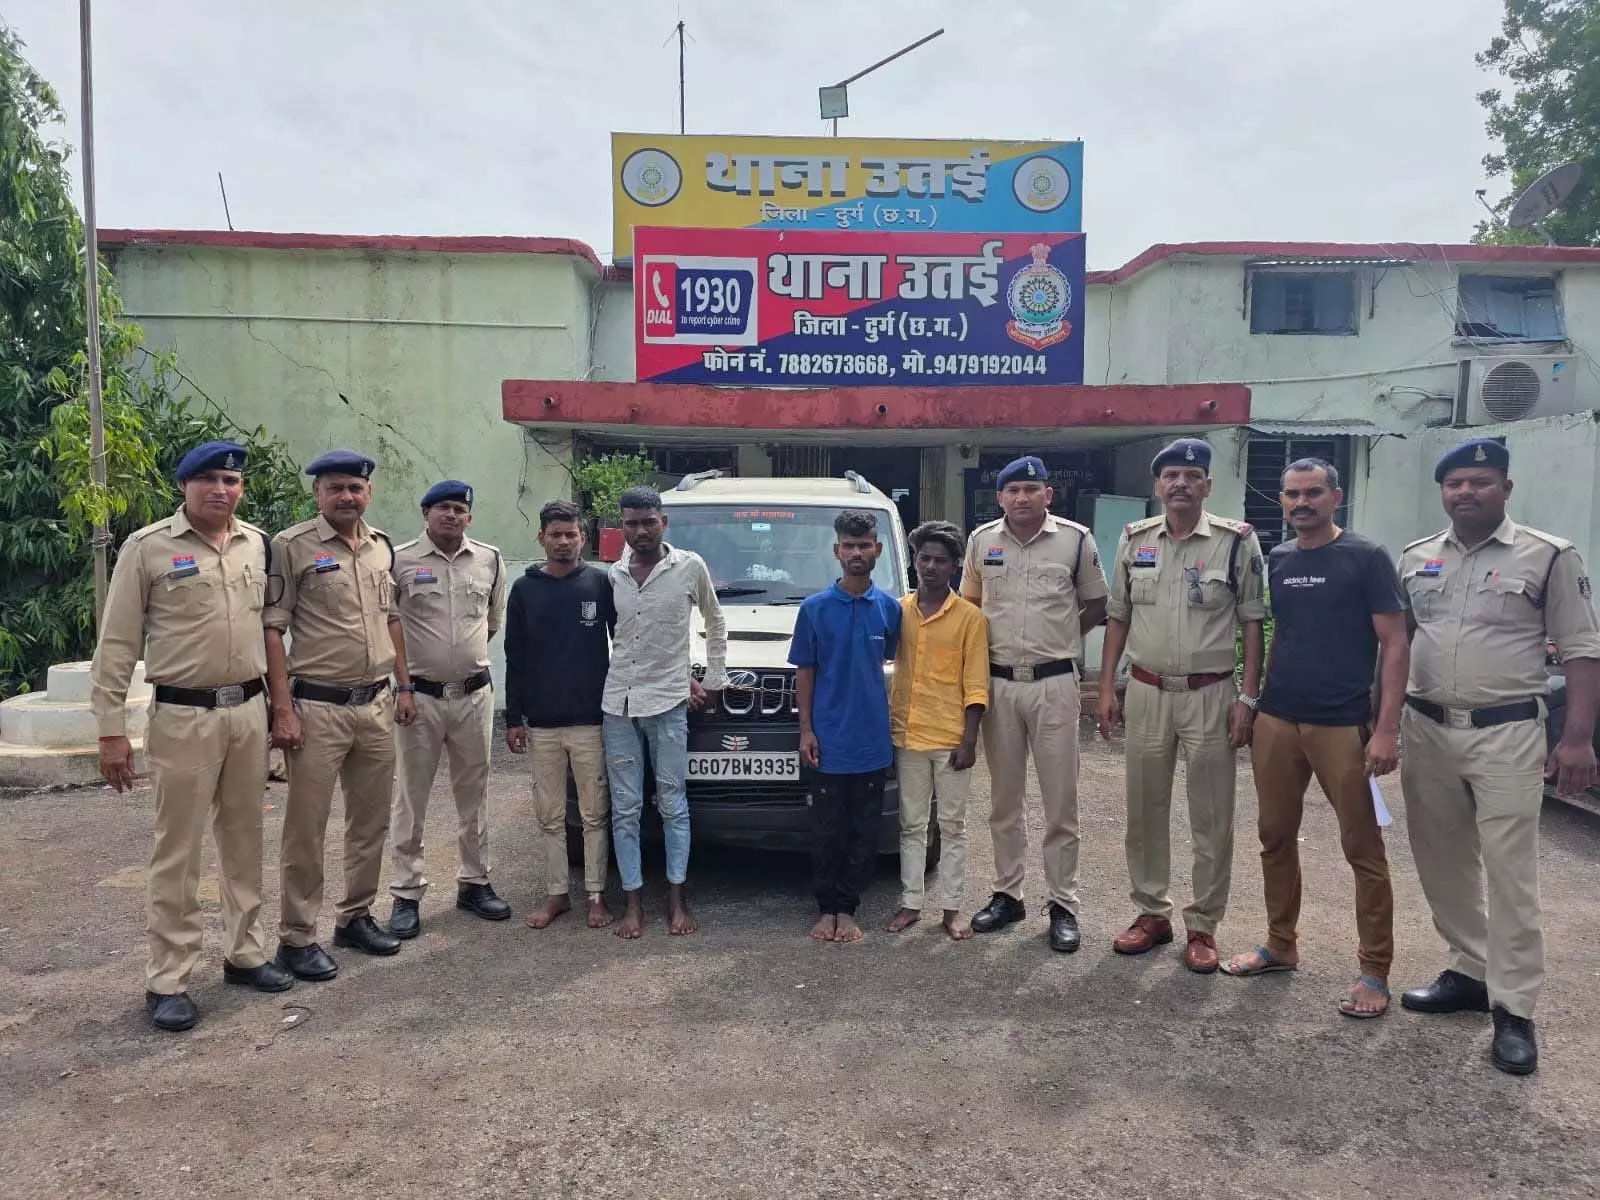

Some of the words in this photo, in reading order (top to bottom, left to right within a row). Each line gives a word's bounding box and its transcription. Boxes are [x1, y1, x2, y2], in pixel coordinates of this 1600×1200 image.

[706, 152, 849, 196] थाना
[861, 147, 992, 203] उतई
[760, 201, 808, 222] जिला
[834, 202, 864, 228] दुर्ग
[873, 204, 937, 229] (छ.ग.)
[768, 254, 887, 299] थाना
[896, 241, 1004, 307] उतई
[681, 277, 741, 313] 1930
[646, 309, 672, 324] DIAL
[681, 315, 687, 324] to
[689, 315, 706, 327] report
[707, 315, 723, 327] cyber
[724, 316, 741, 326] crime
[794, 310, 847, 336] जिला
[865, 311, 895, 343] दुर्ग
[899, 311, 968, 341] (छ.ग.)
[703, 346, 746, 371] फोन
[749, 349, 772, 373] नं.
[779, 353, 895, 377] 7882673668,
[688, 758, 796, 776] CG07BW3935
